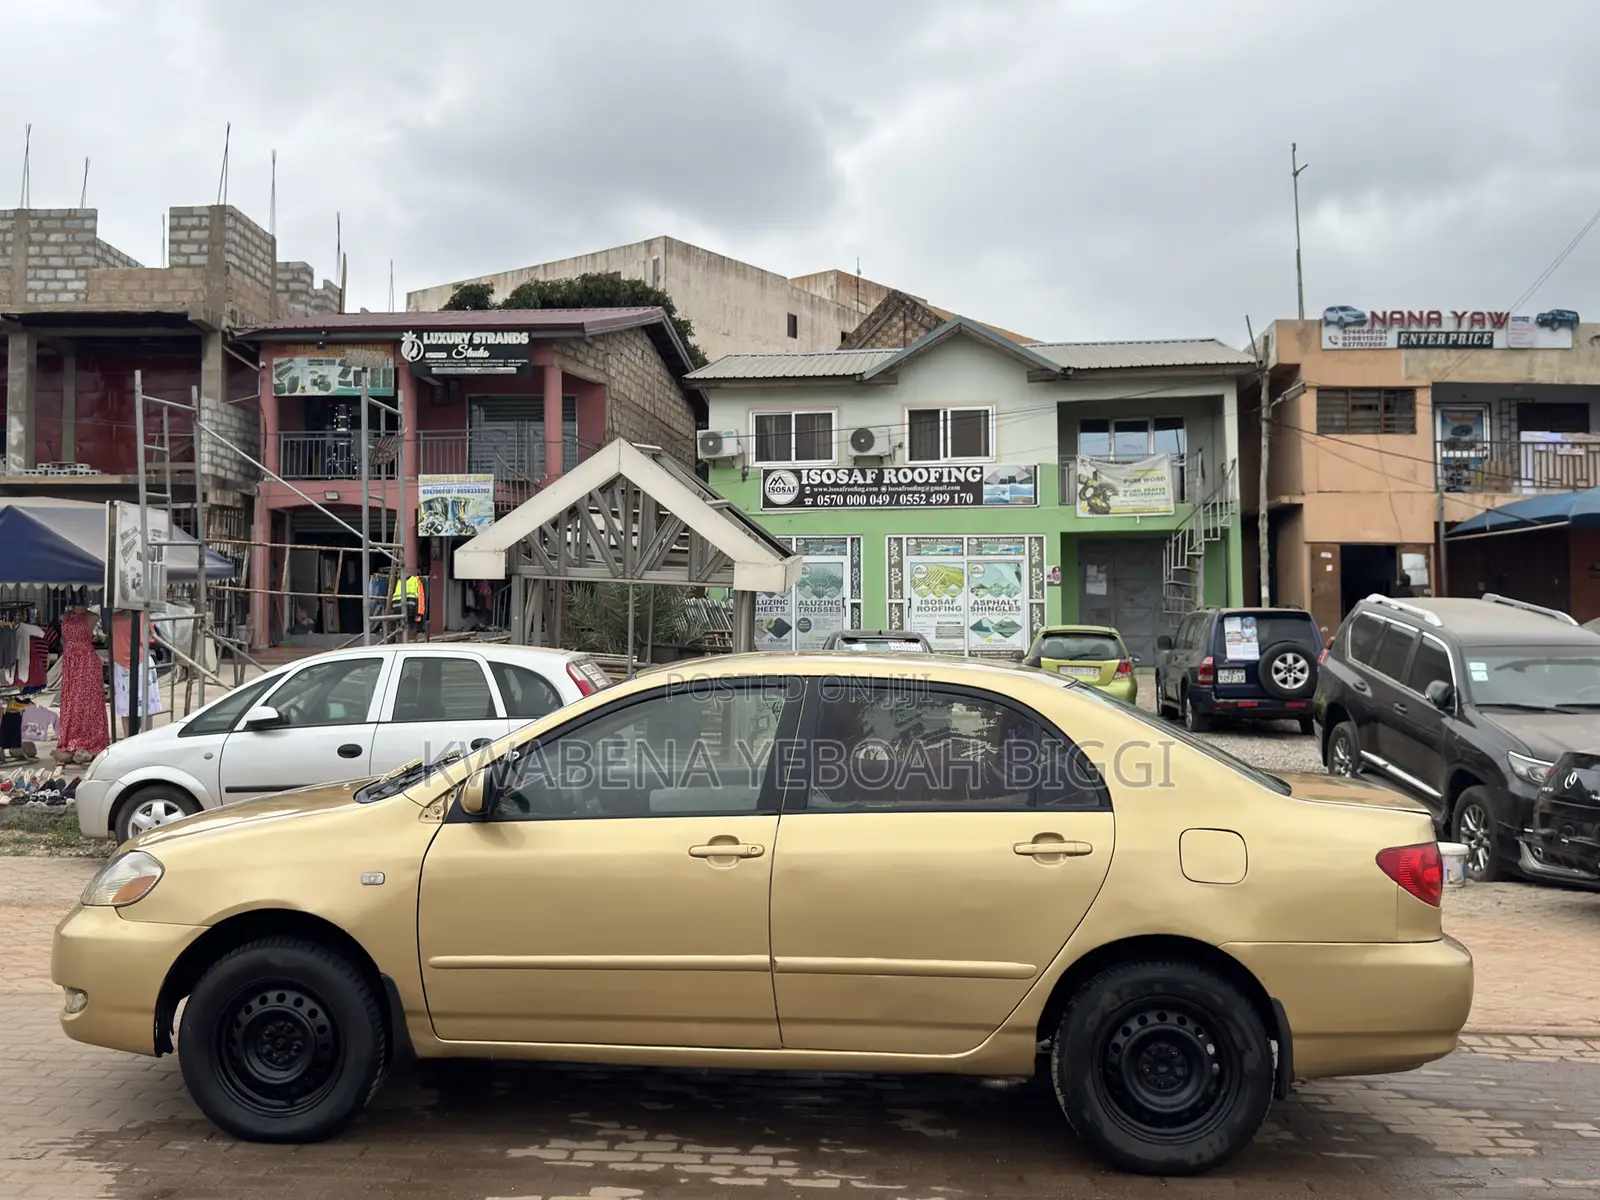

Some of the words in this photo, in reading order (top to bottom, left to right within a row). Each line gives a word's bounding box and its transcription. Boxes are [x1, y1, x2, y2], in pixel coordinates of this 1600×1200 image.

[1370, 310, 1442, 329] NANA
[1450, 310, 1510, 329] YAW
[423, 331, 471, 345] LUXURY
[472, 331, 529, 345] STRANDS
[452, 344, 490, 359] Studio
[800, 468, 879, 485] ISOSAF
[882, 466, 982, 484] ROOFING
[1123, 477, 1141, 485] PURE
[768, 486, 797, 494] ISOSAF
[813, 485, 879, 493] www.isosafroofing.com
[817, 494, 843, 506] 0570
[846, 494, 867, 506] 000
[869, 494, 890, 505] 049
[892, 494, 897, 505] /
[899, 493, 926, 505] 0552
[929, 493, 950, 505] 499
[954, 493, 973, 504] 170
[798, 599, 841, 607] ALUZINC
